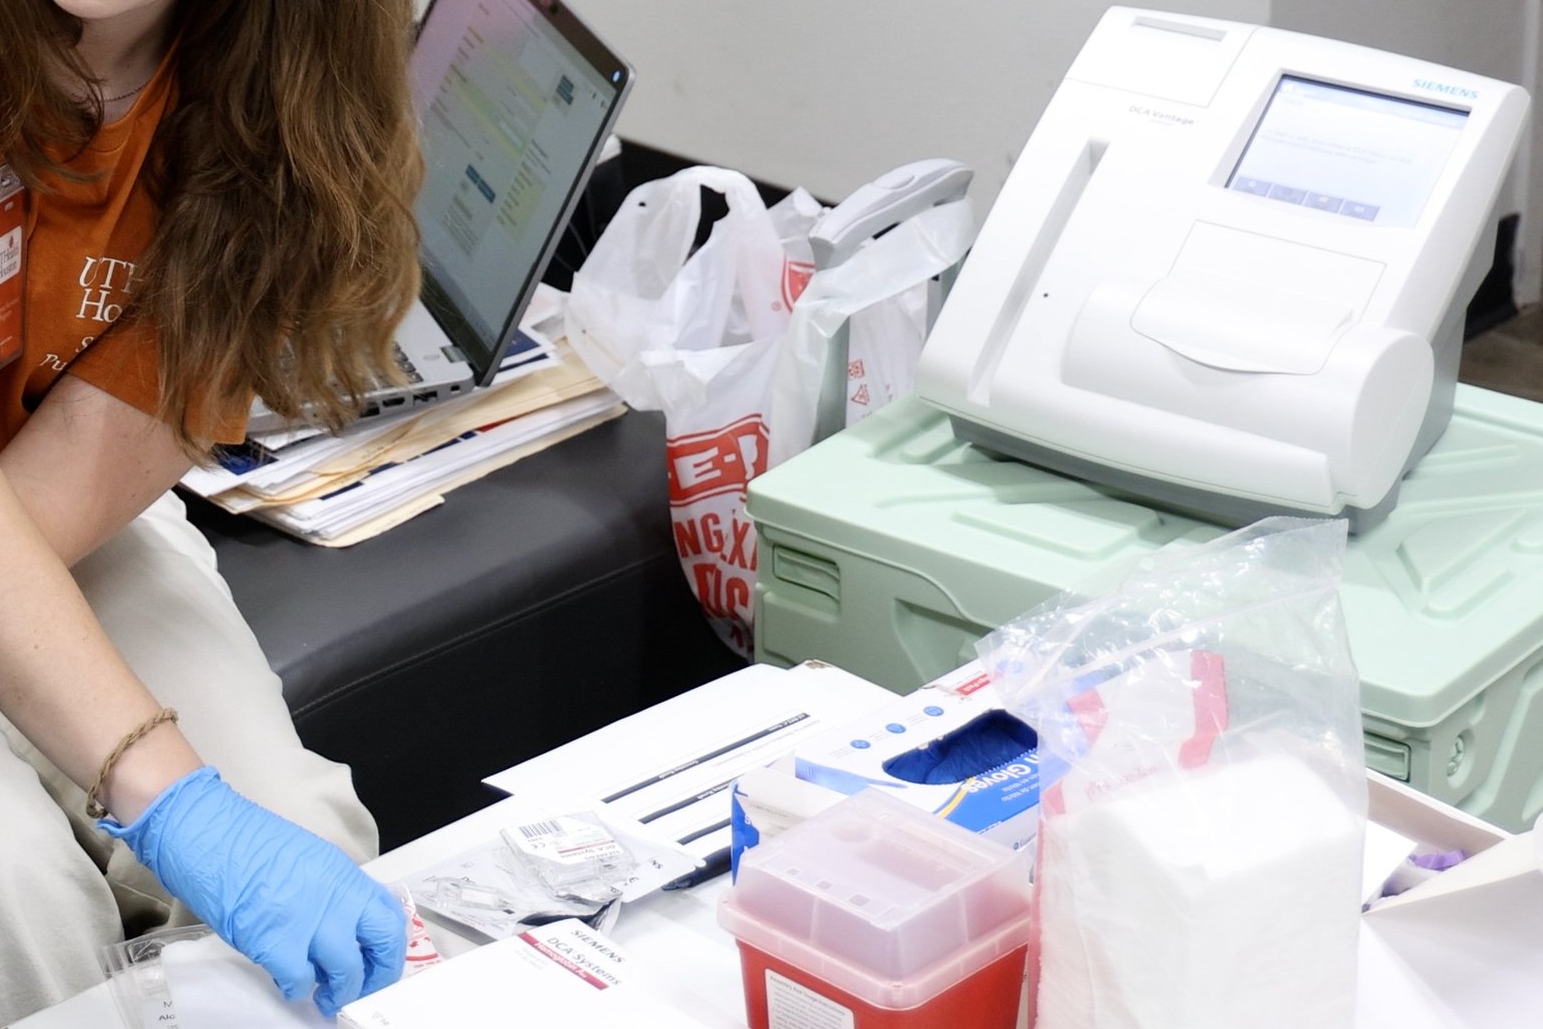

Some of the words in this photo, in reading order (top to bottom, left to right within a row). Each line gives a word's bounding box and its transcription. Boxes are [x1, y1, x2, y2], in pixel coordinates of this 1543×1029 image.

[1412, 78, 1481, 100] SIEMENS
[75, 288, 123, 323] Ho
[39, 353, 68, 372] Pu
[960, 763, 1031, 793] Gloves
[546, 937, 574, 955] DCA
[573, 953, 622, 986] Systems
[571, 929, 626, 964] SIEMENS
